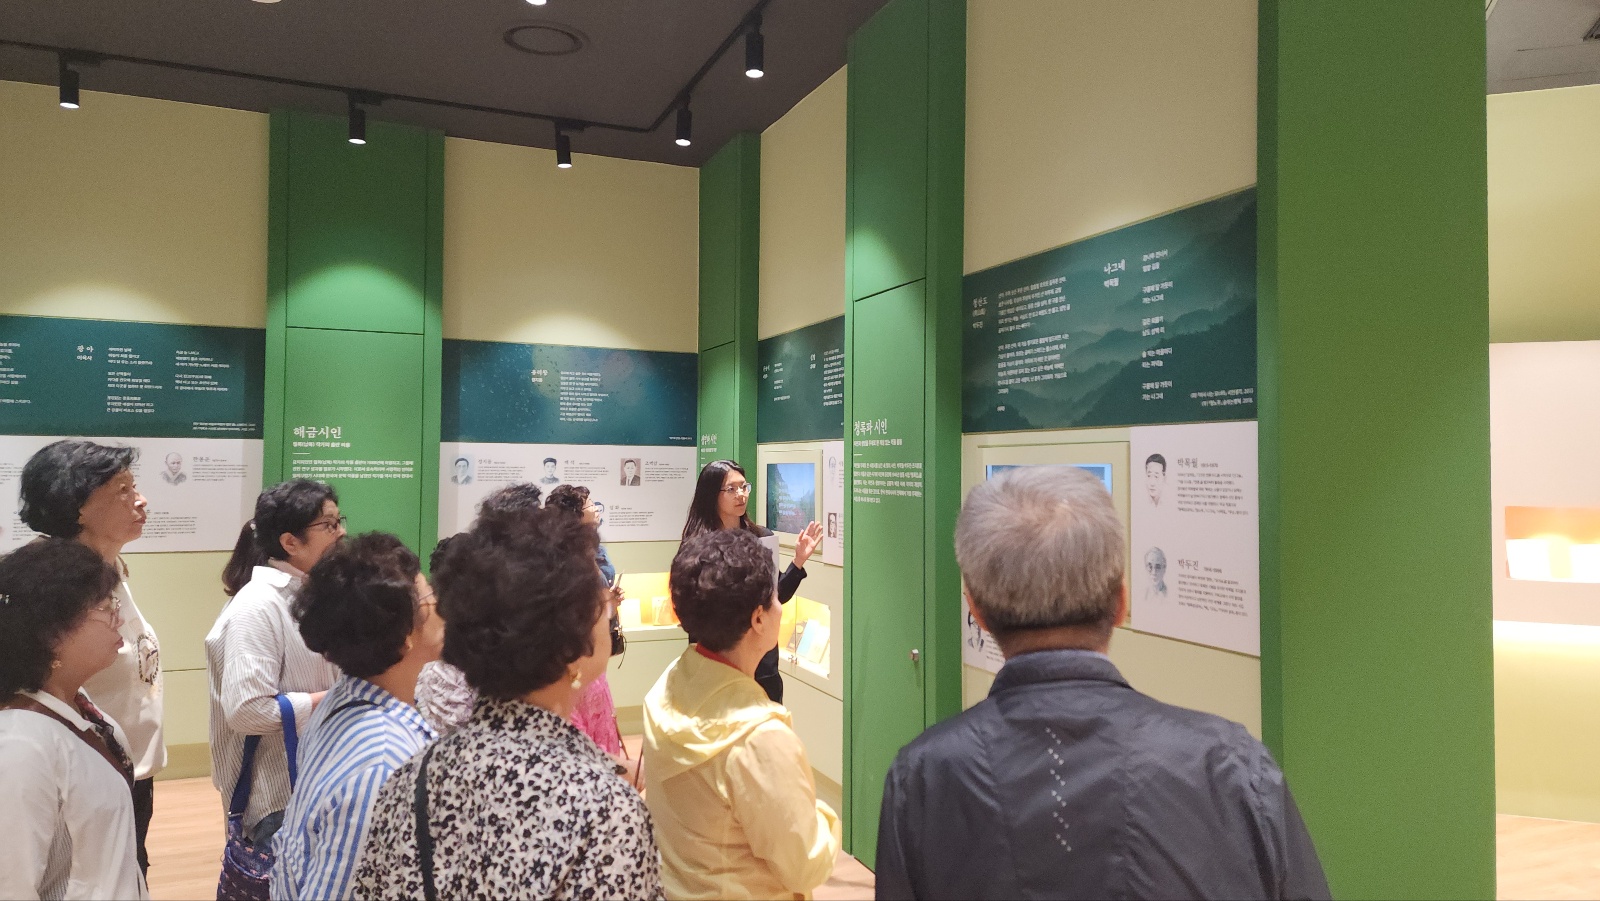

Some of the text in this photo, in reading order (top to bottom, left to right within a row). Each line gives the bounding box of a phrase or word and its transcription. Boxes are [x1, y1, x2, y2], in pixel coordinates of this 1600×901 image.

[1103, 258, 1126, 275] 나그네
[1103, 277, 1120, 289] 박목월
[293, 425, 342, 439] 해금시인
[854, 418, 888, 436] 청록파 시인
[1177, 457, 1198, 468] 박목월
[1177, 558, 1199, 571] 박두진
